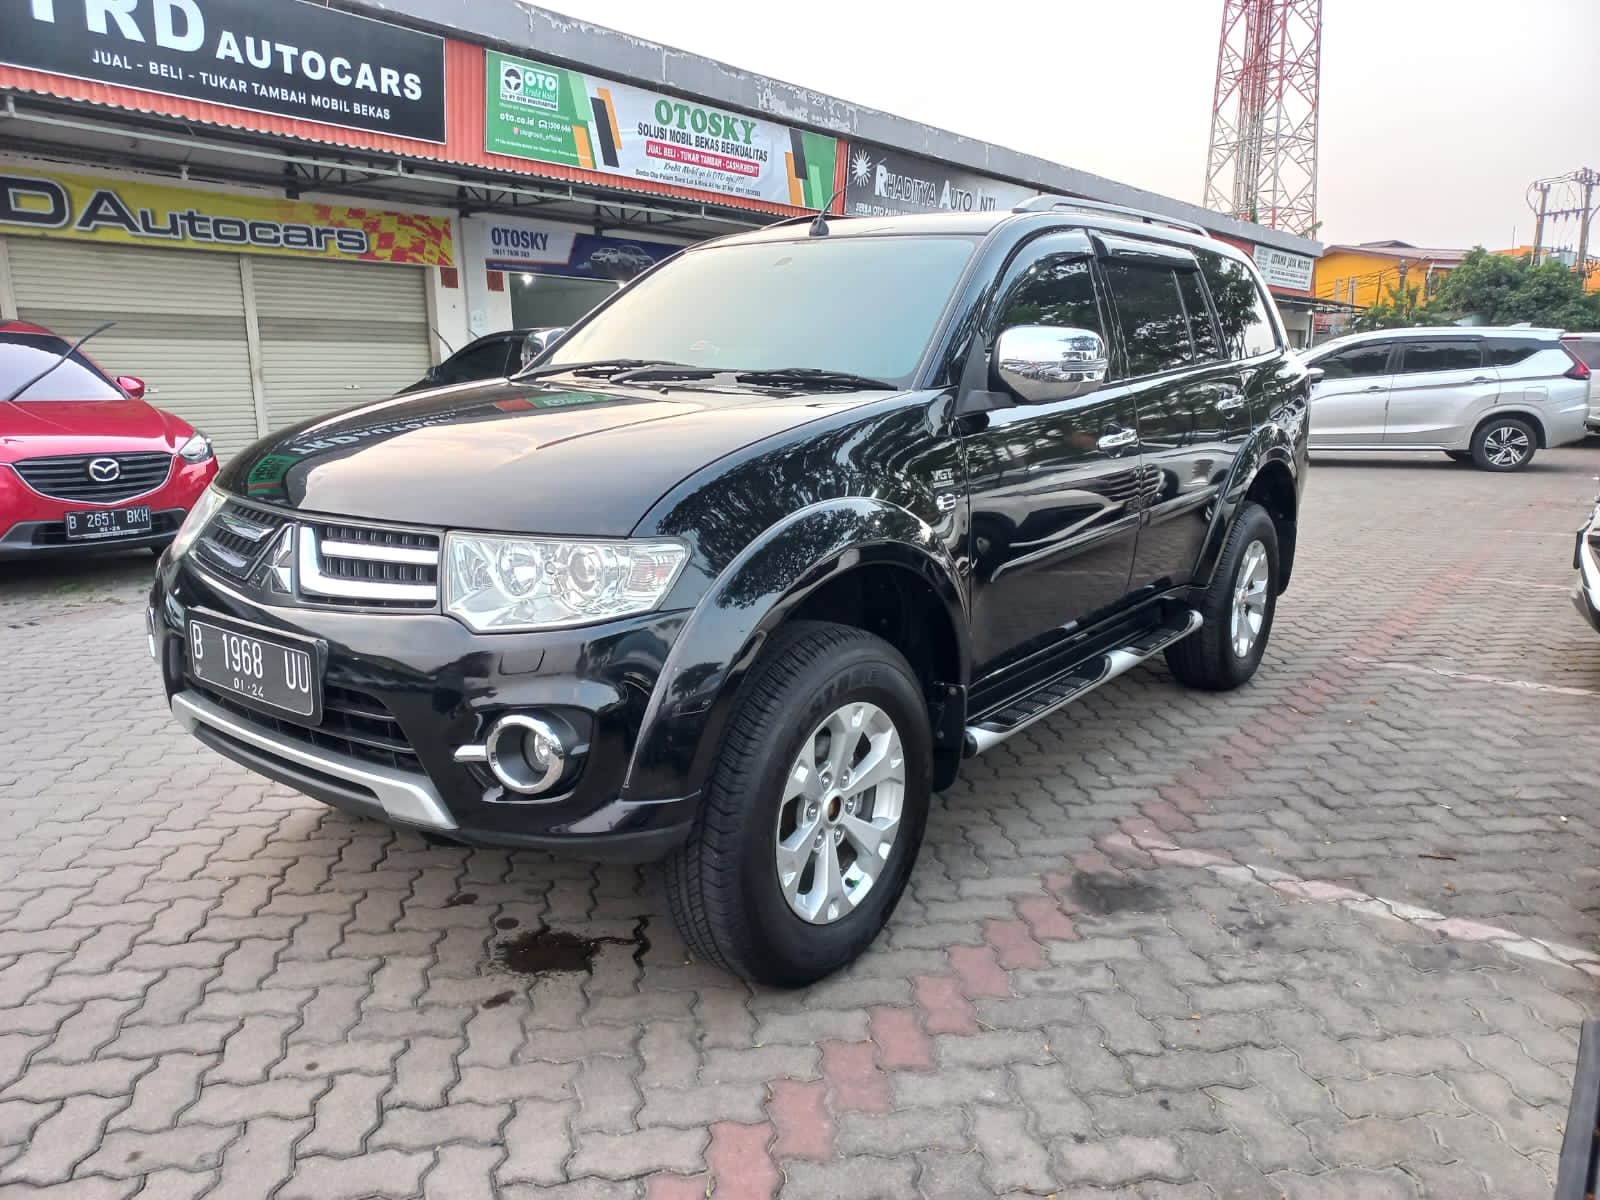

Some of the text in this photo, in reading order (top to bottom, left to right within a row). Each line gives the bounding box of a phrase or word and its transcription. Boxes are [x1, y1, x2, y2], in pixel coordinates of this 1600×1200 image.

[92, 49, 132, 70] JUAL
[149, 60, 183, 81] BELI
[199, 71, 248, 94] TUKAR
[252, 82, 307, 106] TAMBAH
[311, 94, 350, 113] MOBIL
[353, 102, 391, 120] BEKAS
[215, 29, 423, 101] AUTOCARS
[524, 71, 556, 90] OTO
[499, 112, 534, 126] oto.co.id
[655, 99, 757, 145] OTOSKY
[637, 121, 768, 162] SOLUSI MOBIL BEKAS BERKUALITAS
[647, 143, 662, 155] JUAL
[663, 147, 676, 158] BELI
[680, 150, 699, 162] TUKAR
[875, 164, 937, 208] RHADITYA
[939, 180, 973, 212] AUTO
[74, 188, 370, 254] Autocars
[491, 227, 549, 252] OTOSKY
[69, 508, 148, 529] B 2651 BKH
[193, 623, 309, 693] B 1968 UU
